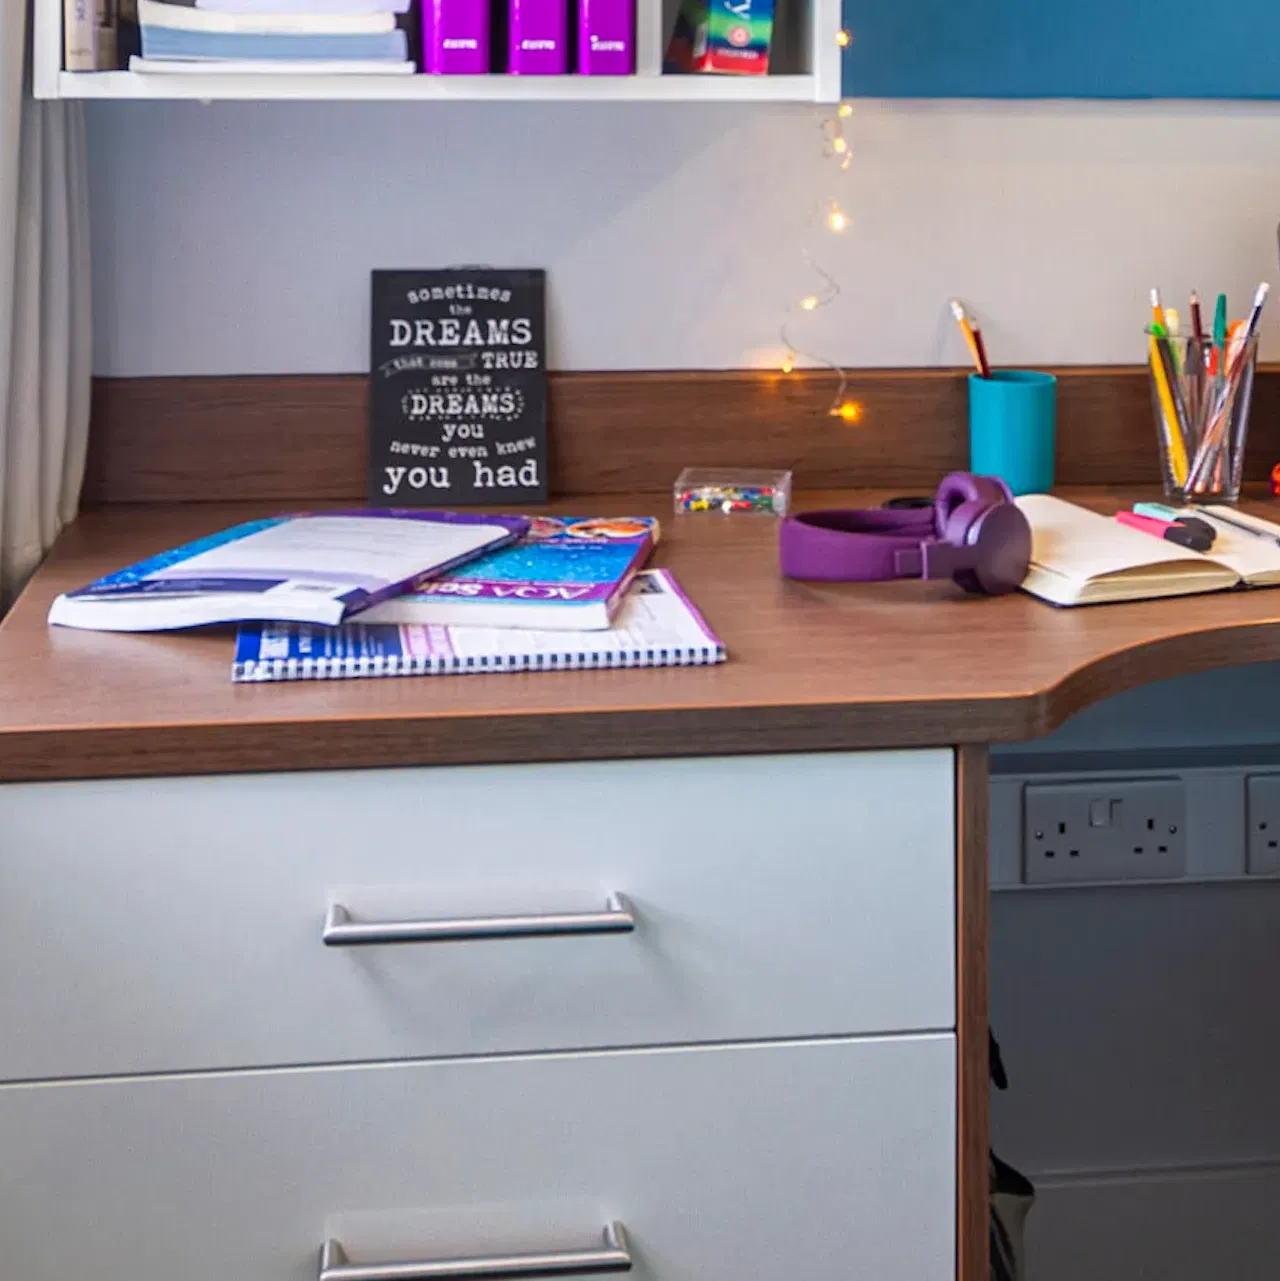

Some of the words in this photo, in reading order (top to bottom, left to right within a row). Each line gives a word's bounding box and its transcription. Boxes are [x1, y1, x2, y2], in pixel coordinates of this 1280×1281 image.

[406, 283, 512, 304] sometimes
[449, 304, 472, 316] the
[389, 318, 532, 346] DREAMS
[393, 356, 424, 370] that
[429, 358, 458, 369] come
[481, 350, 539, 369] TRUE
[431, 375, 458, 387] are
[465, 373, 492, 386] the
[410, 393, 516, 416] DREAMS
[441, 423, 485, 442] you
[389, 440, 441, 458] never
[447, 445, 489, 458] even
[495, 436, 537, 456] knew
[382, 466, 452, 495] you
[472, 458, 540, 488] had
